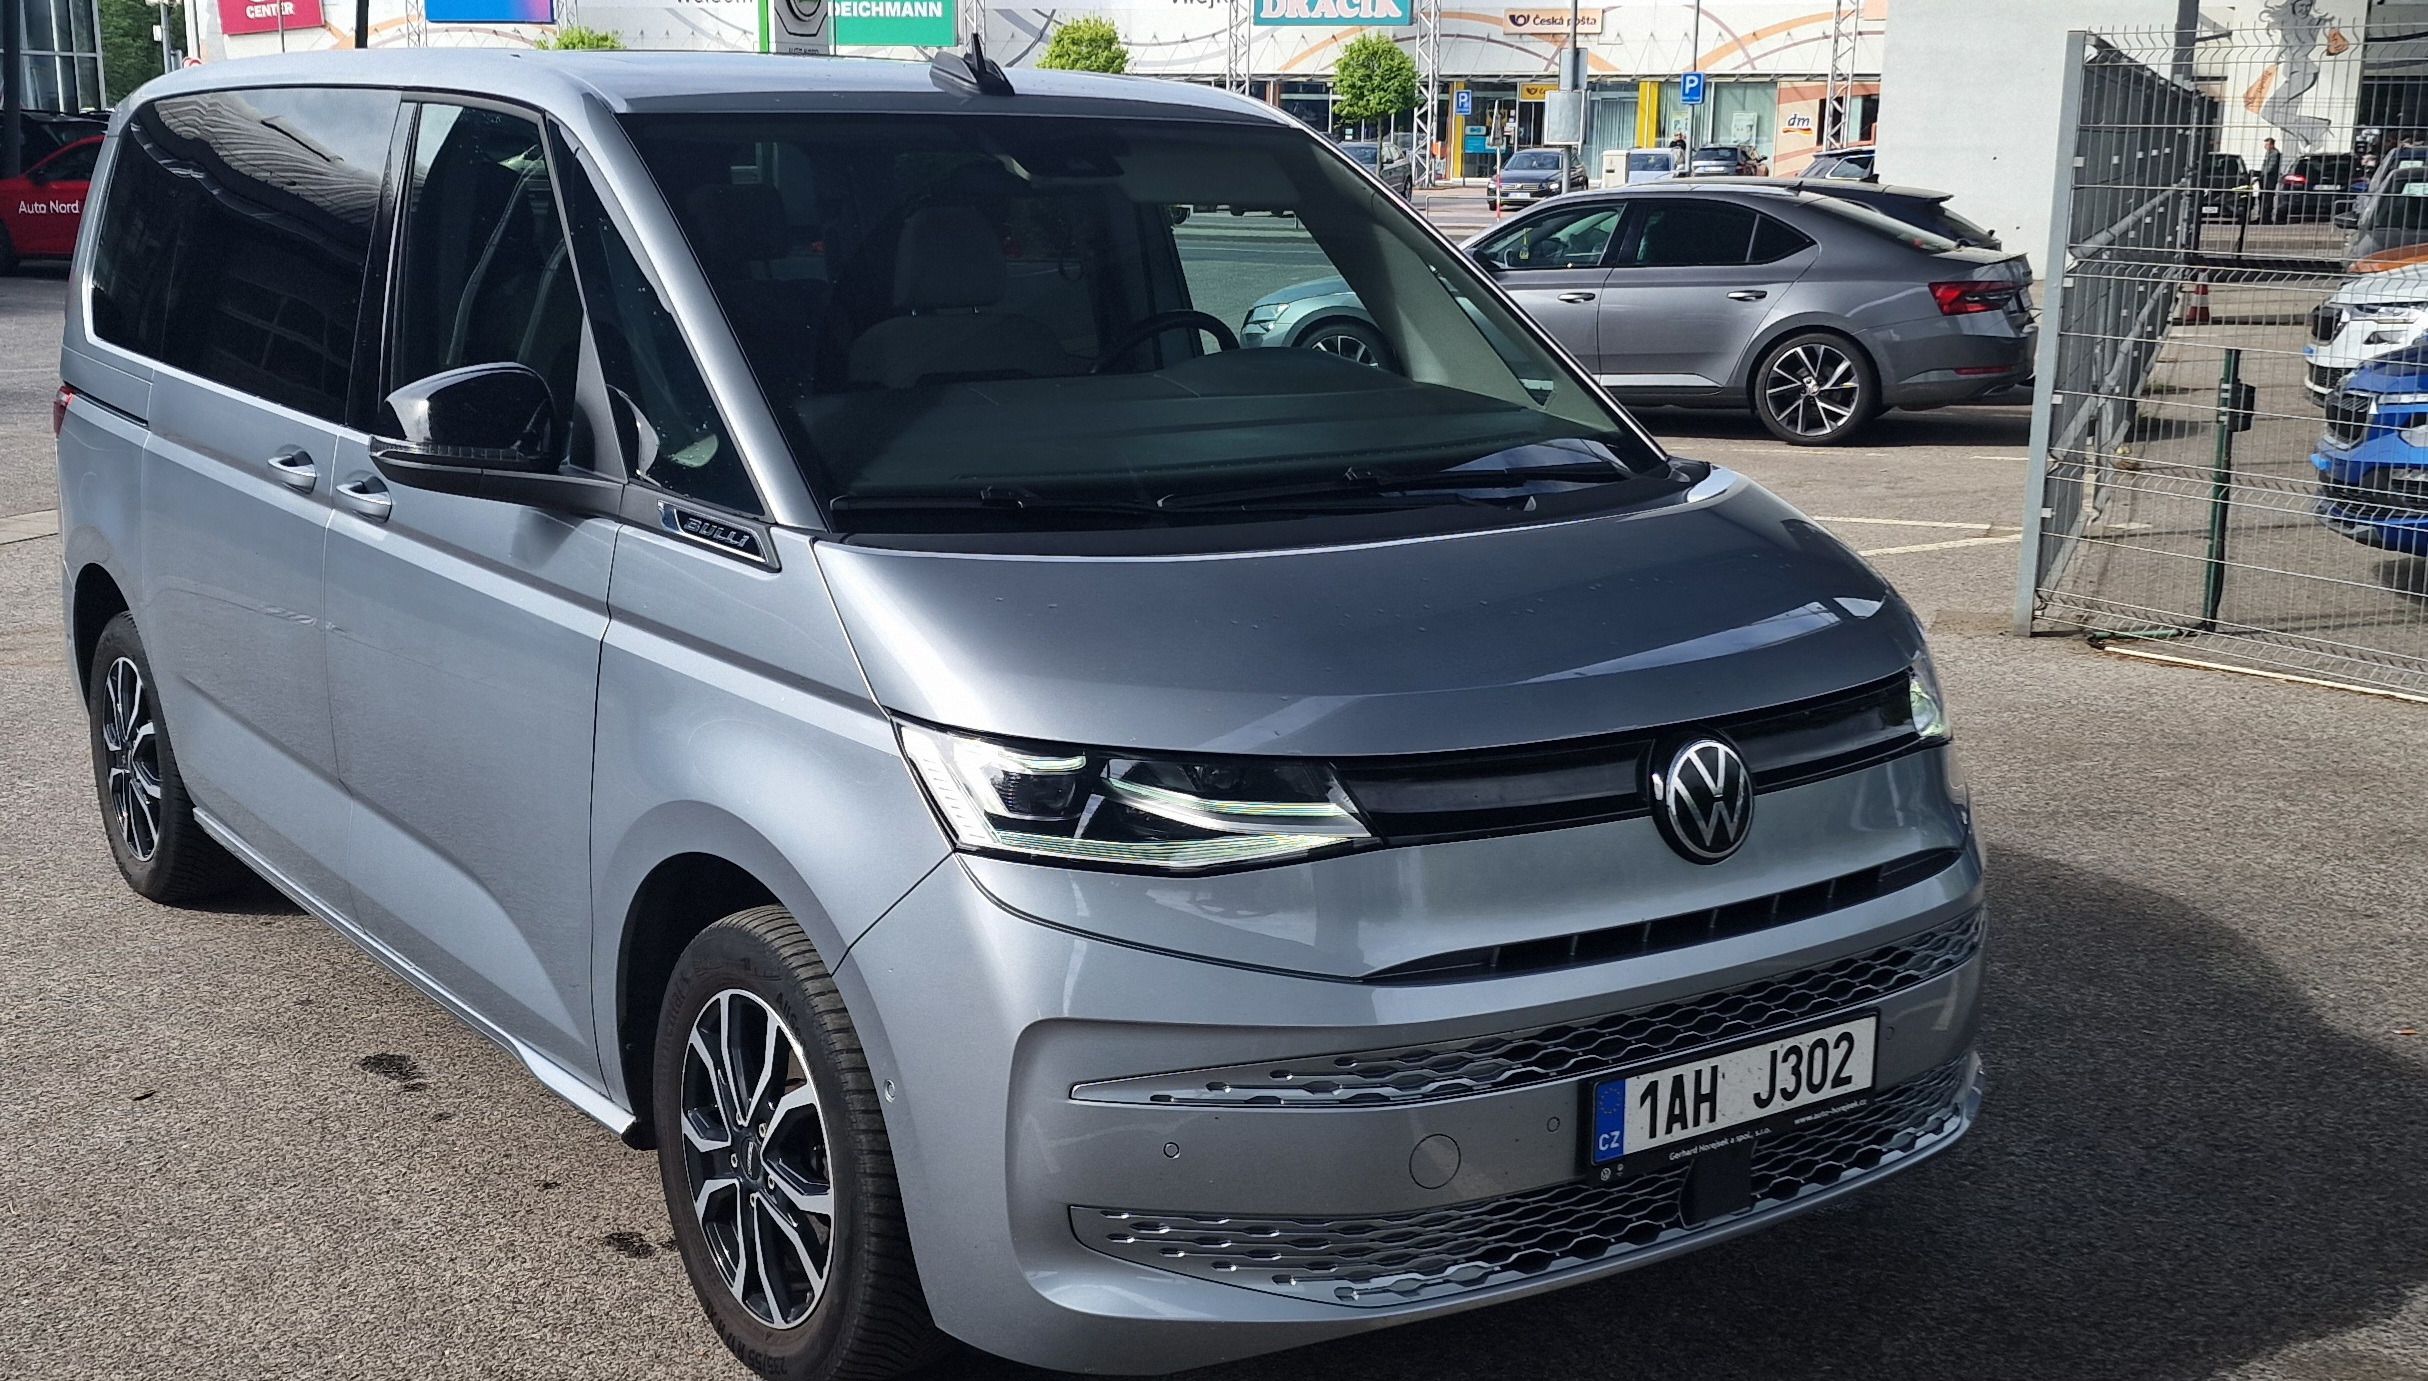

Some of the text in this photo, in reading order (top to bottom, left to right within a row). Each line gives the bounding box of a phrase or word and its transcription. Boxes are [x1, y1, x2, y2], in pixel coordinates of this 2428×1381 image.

[828, 1, 943, 17] DEICHMANN
[1533, 15, 1564, 26] Česká
[1685, 75, 1699, 94] P
[1459, 93, 1468, 107] P
[1787, 113, 1810, 127] dm
[19, 200, 79, 214] Auto Nord
[683, 517, 750, 548] BULLI
[1639, 1031, 1855, 1139] 1AH J302
[1599, 1130, 1620, 1151] CZ
[1668, 1145, 1698, 1161] Gerhard
